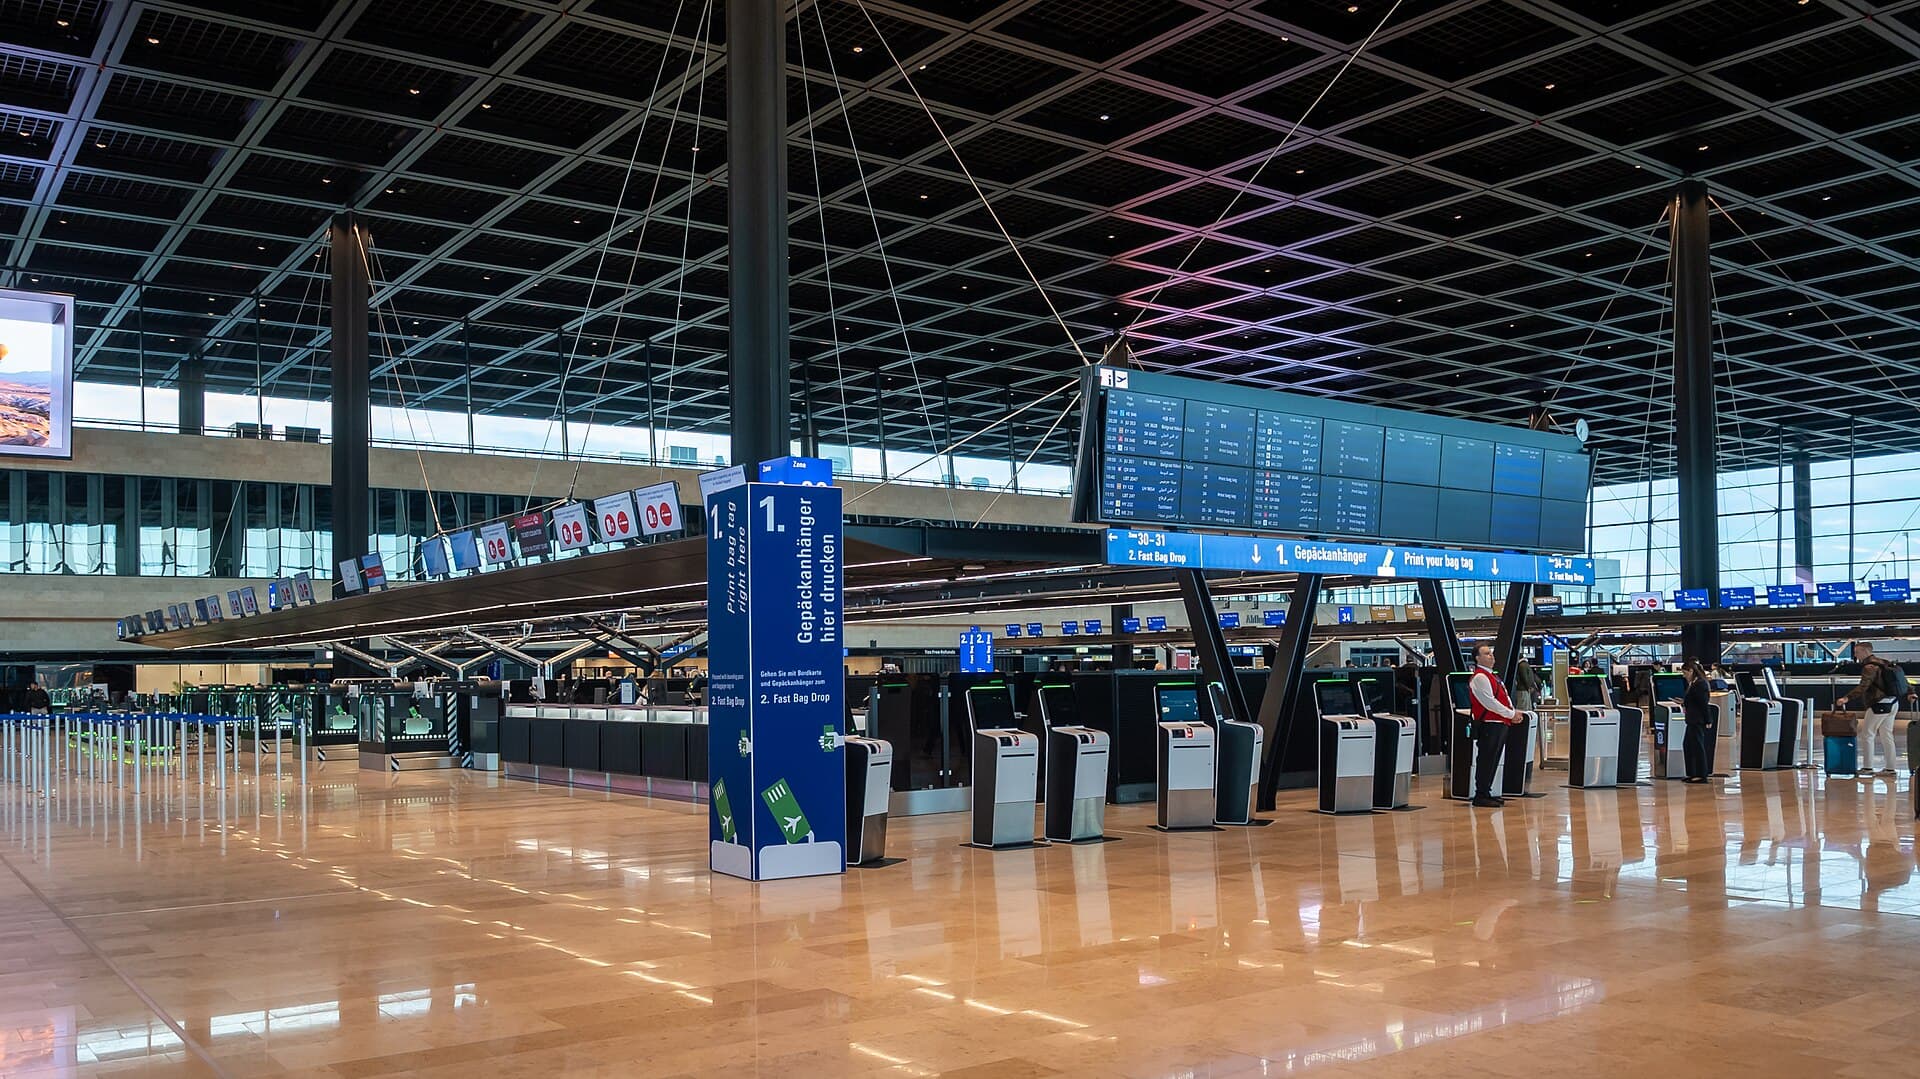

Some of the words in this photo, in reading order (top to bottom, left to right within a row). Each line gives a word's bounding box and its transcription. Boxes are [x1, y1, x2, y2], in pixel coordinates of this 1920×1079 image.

[710, 504, 723, 540] 1.
[728, 502, 736, 528] tag
[759, 496, 785, 532] 1.
[727, 536, 737, 568] bag
[1129, 550, 1136, 560] 2.
[1138, 550, 1153, 561] Fast
[1154, 551, 1168, 564] Bag
[1170, 552, 1186, 565] Drop
[1276, 544, 1288, 565] 1.
[1294, 544, 1368, 566] Gepäckanhänger
[1404, 552, 1424, 566] Print
[1426, 556, 1443, 568] your
[1444, 554, 1459, 570] bag
[1461, 557, 1473, 571] tag
[796, 497, 816, 644] Gepäckanhänger
[820, 534, 835, 603] drucken
[727, 572, 736, 614] Print
[739, 571, 748, 614] right
[820, 608, 835, 643] hier
[1342, 613, 1350, 621] 34
[761, 694, 769, 704] 2.
[774, 694, 790, 704] Fast
[794, 693, 808, 704] Bag
[812, 692, 830, 703] Drop
[772, 679, 814, 688] Gepäckanhänger
[712, 696, 717, 705] 2.
[735, 697, 744, 708] Drop
